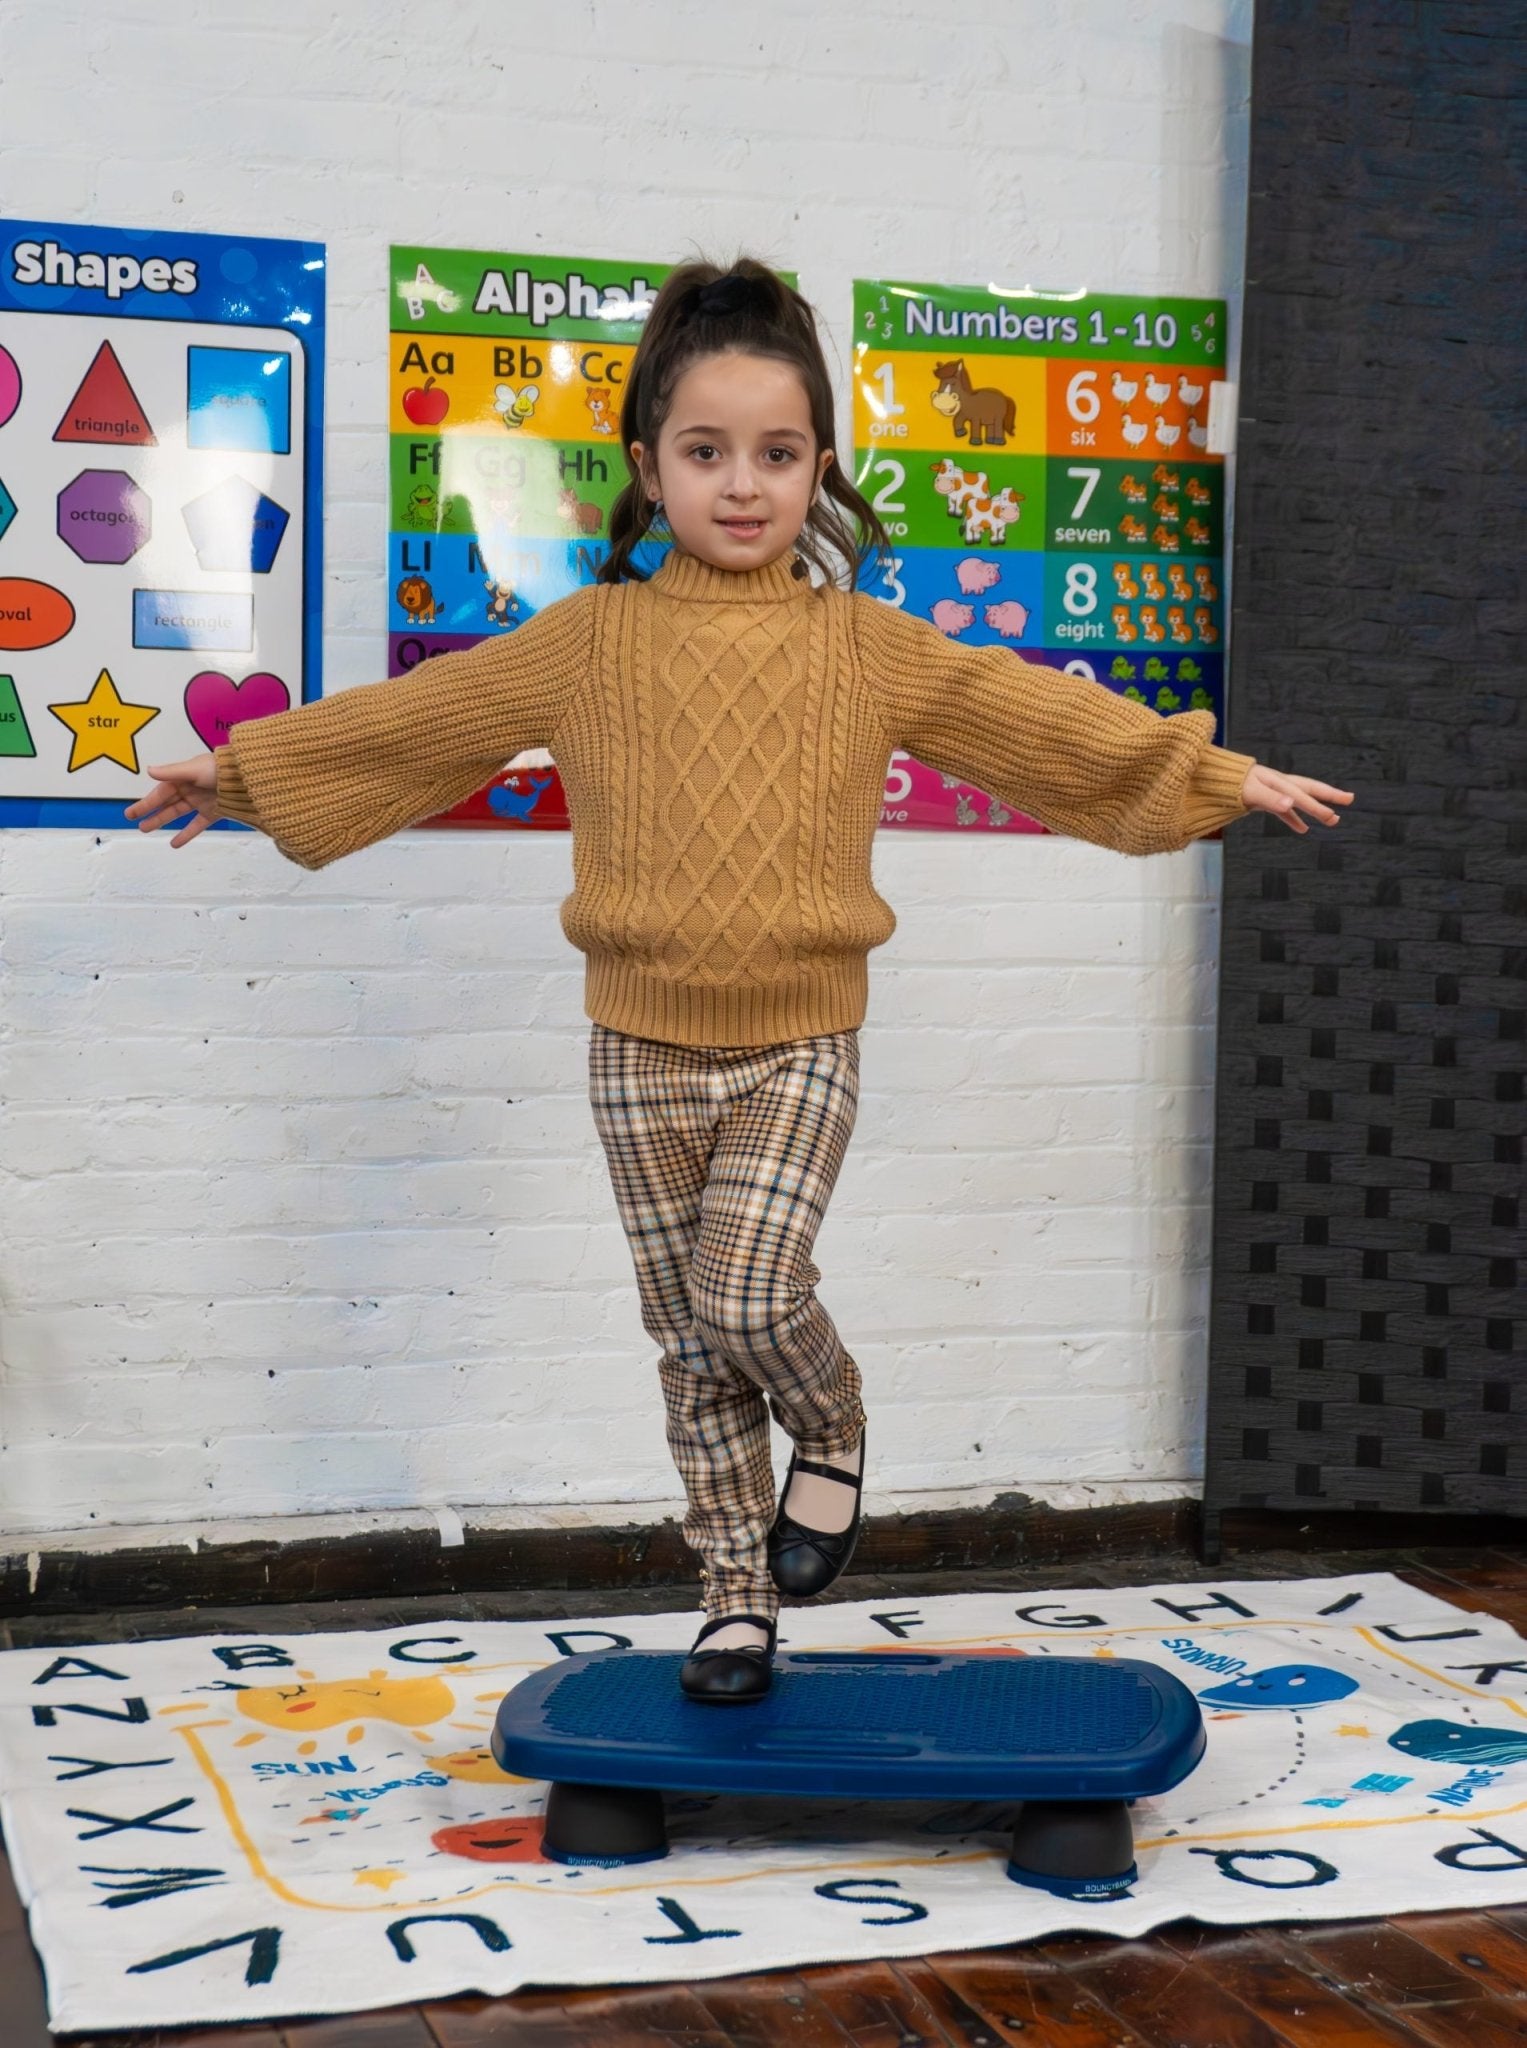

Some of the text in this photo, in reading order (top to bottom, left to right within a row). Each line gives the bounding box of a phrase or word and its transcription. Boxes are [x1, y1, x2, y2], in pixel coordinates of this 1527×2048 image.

[12, 240, 199, 299] Shapes
[415, 263, 435, 287] A
[406, 295, 425, 320] B
[473, 269, 660, 327] Alphab
[879, 295, 890, 313] 1
[864, 311, 876, 329] 2
[881, 321, 893, 340] 3
[905, 299, 1079, 343] Numbers
[1191, 323, 1202, 342] 5
[399, 342, 455, 375] Aa
[1205, 338, 1216, 354] 6
[493, 345, 543, 378] Bb
[579, 351, 623, 383] Cc
[873, 362, 905, 416] 1
[1066, 370, 1100, 423] 6
[74, 416, 140, 437] triangle
[869, 422, 908, 438] one
[1071, 428, 1097, 446] six
[559, 449, 608, 482] Hh
[873, 459, 906, 513] 2
[1066, 467, 1101, 520] 7
[883, 522, 909, 537] wo
[1055, 526, 1111, 544] seven
[402, 540, 431, 571] Ll
[876, 557, 907, 608] 3
[1063, 562, 1098, 616] 8
[154, 615, 233, 633] rectangle
[1055, 620, 1105, 642] eight
[88, 715, 120, 728] star
[883, 750, 912, 802] 5
[880, 805, 909, 823] ive
[1015, 1605, 1109, 1628] G
[1151, 1592, 1257, 1622] H
[869, 1610, 925, 1638] F
[213, 1645, 295, 1670] B
[389, 1637, 478, 1664] C
[545, 1631, 634, 1657] D
[1161, 1638, 1248, 1676] URANUS
[32, 1656, 130, 1685] A
[1443, 1660, 1527, 1685] K
[47, 1755, 175, 1780] Y
[251, 1755, 358, 1776] SUN
[66, 1797, 205, 1840] X
[1433, 1826, 1527, 1872] P
[1188, 1847, 1340, 1889] Q
[814, 1879, 928, 1925] S
[643, 1896, 742, 1944] T
[386, 1913, 512, 1963] U
[126, 1927, 282, 1988] V
